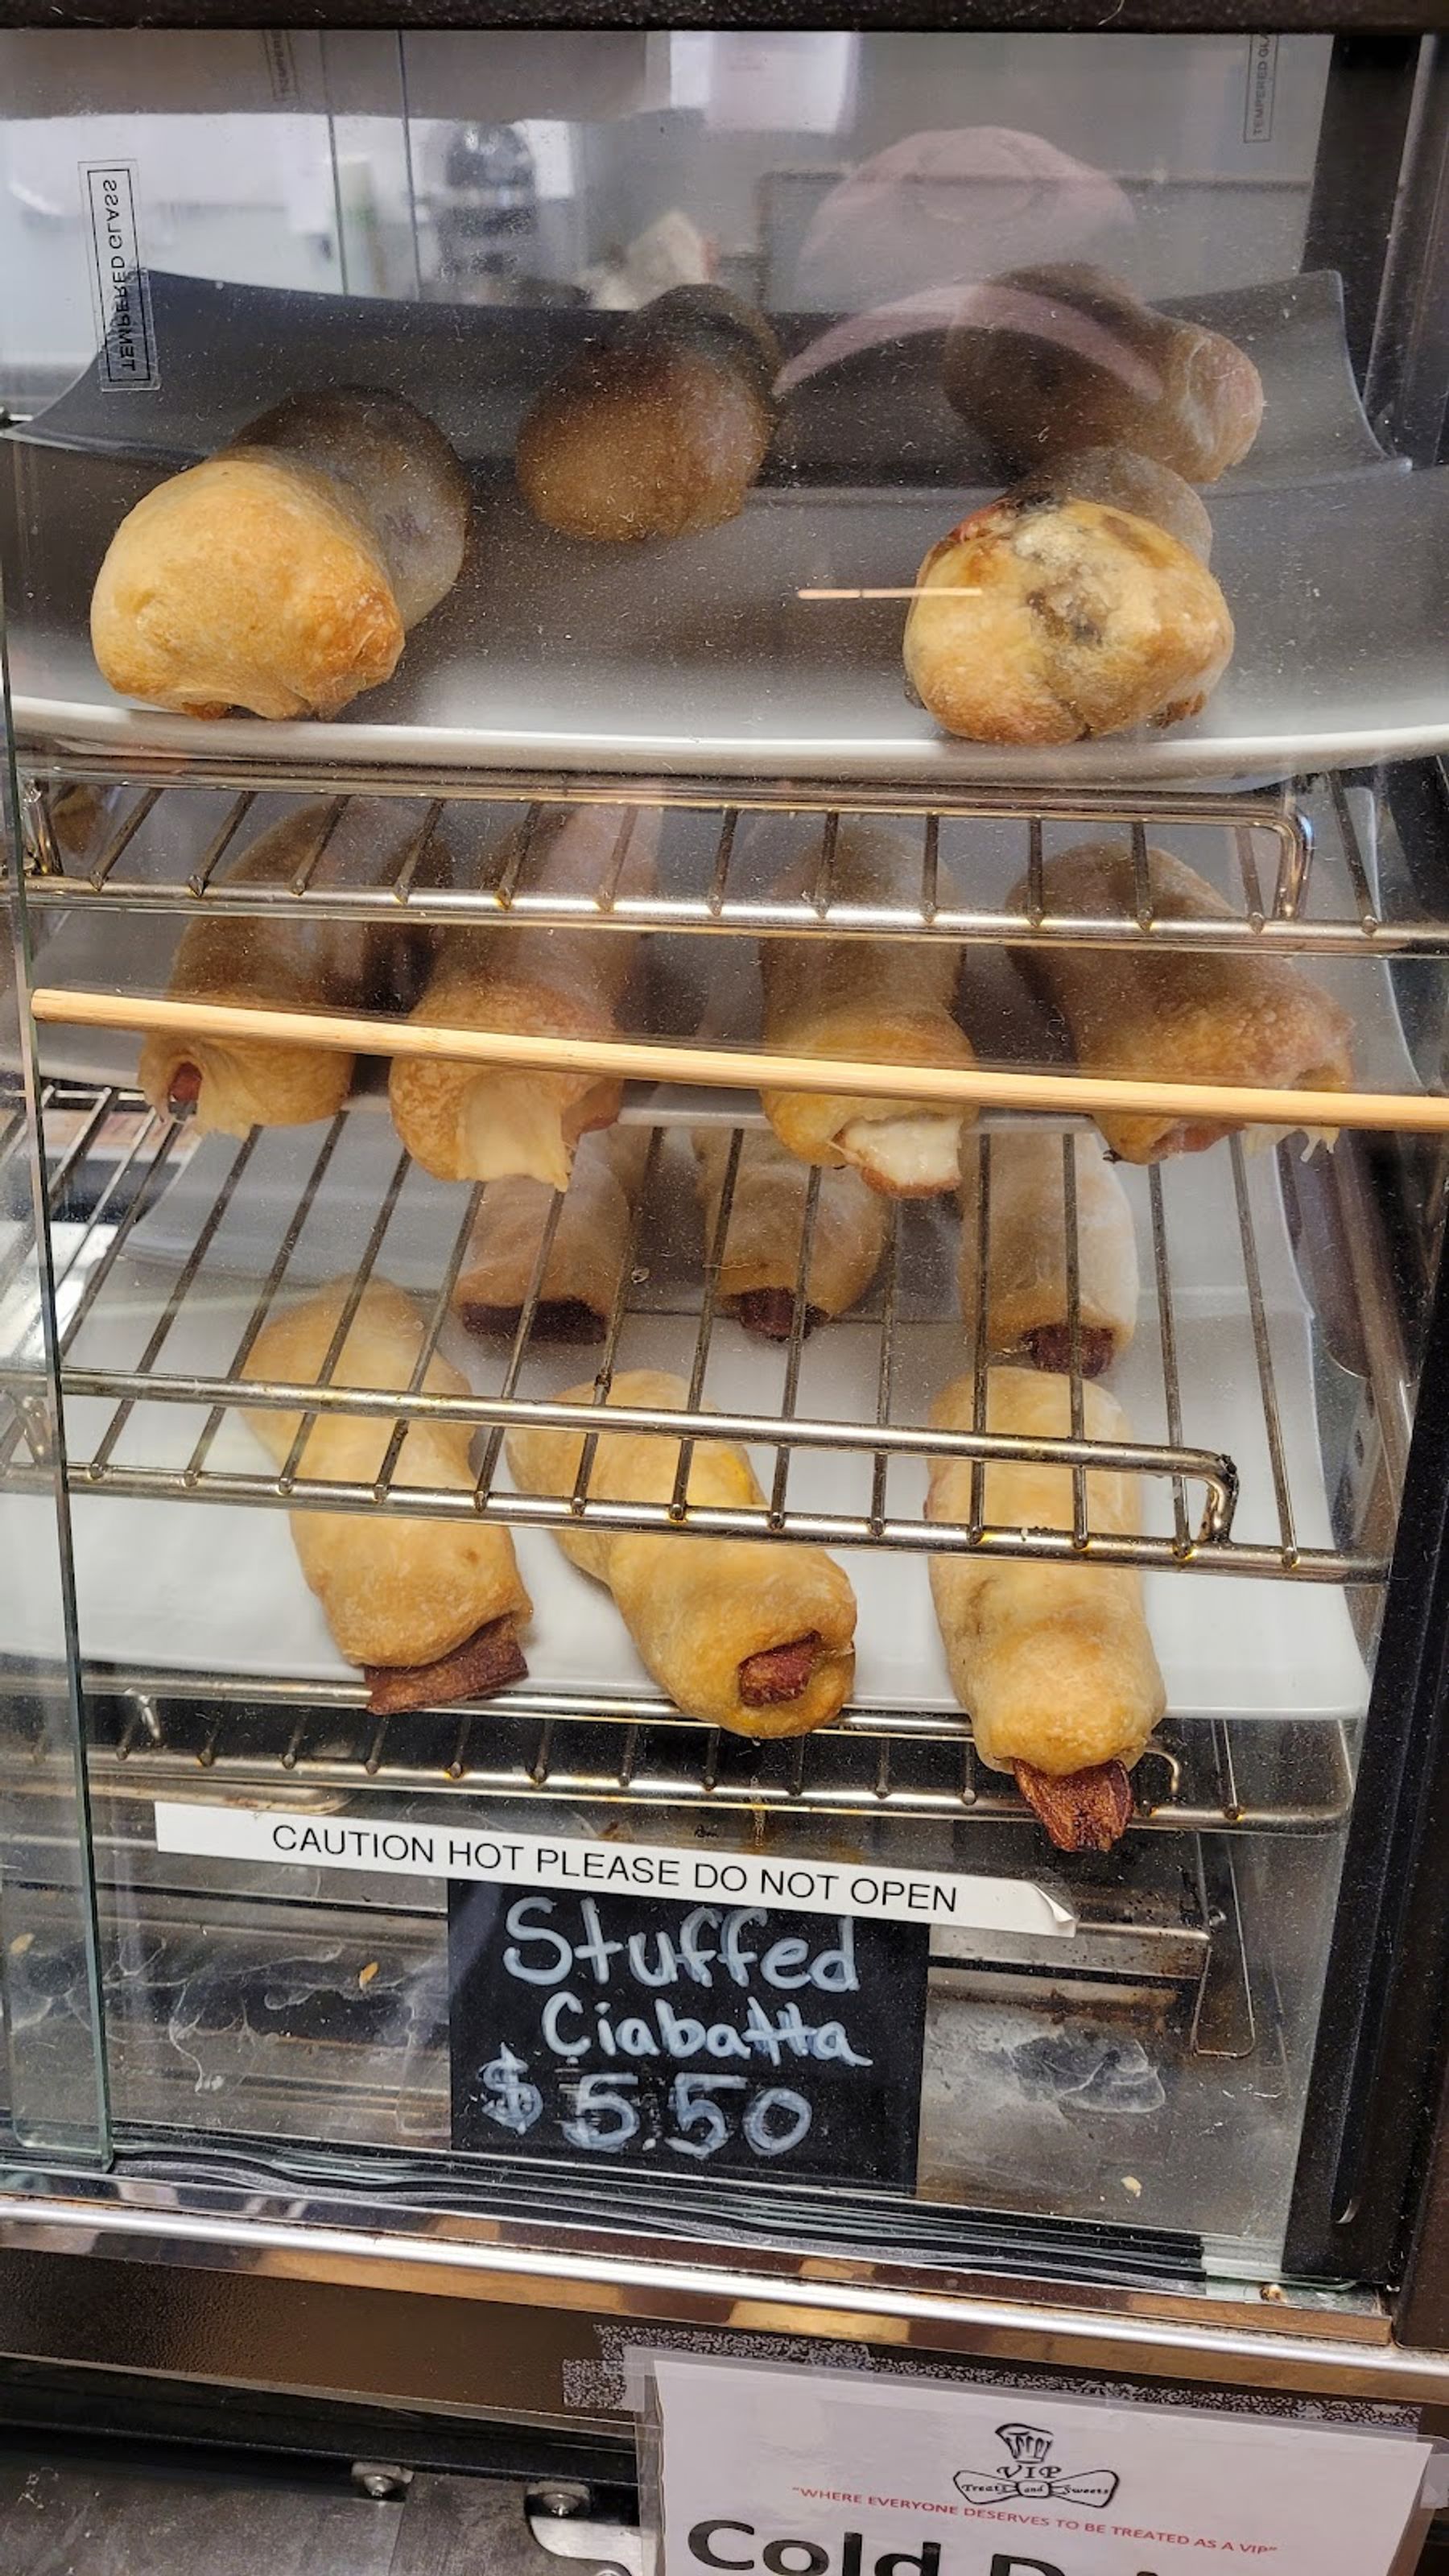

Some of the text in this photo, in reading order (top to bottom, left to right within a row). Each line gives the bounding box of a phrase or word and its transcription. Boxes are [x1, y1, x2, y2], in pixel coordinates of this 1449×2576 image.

[273, 1825, 957, 1913] CAUTION HOT PLEASE DO NOT OPEN
[503, 1896, 861, 1992] Stuffed
[542, 1991, 873, 2066] Ciabatta
[996, 2464, 1062, 2479] VIP
[1023, 2484, 1043, 2494] and
[1063, 2484, 1109, 2495] Sweets
[687, 2519, 942, 2576] Cold
[868, 2496, 959, 2515] EVERYONE
[964, 2507, 1050, 2527] DESERVES
[1055, 2518, 1080, 2531] TO
[1084, 2522, 1105, 2534] BE
[1111, 2525, 1190, 2545] TREATED
[1194, 2537, 1217, 2549] AS
[1221, 2541, 1235, 2551] A
